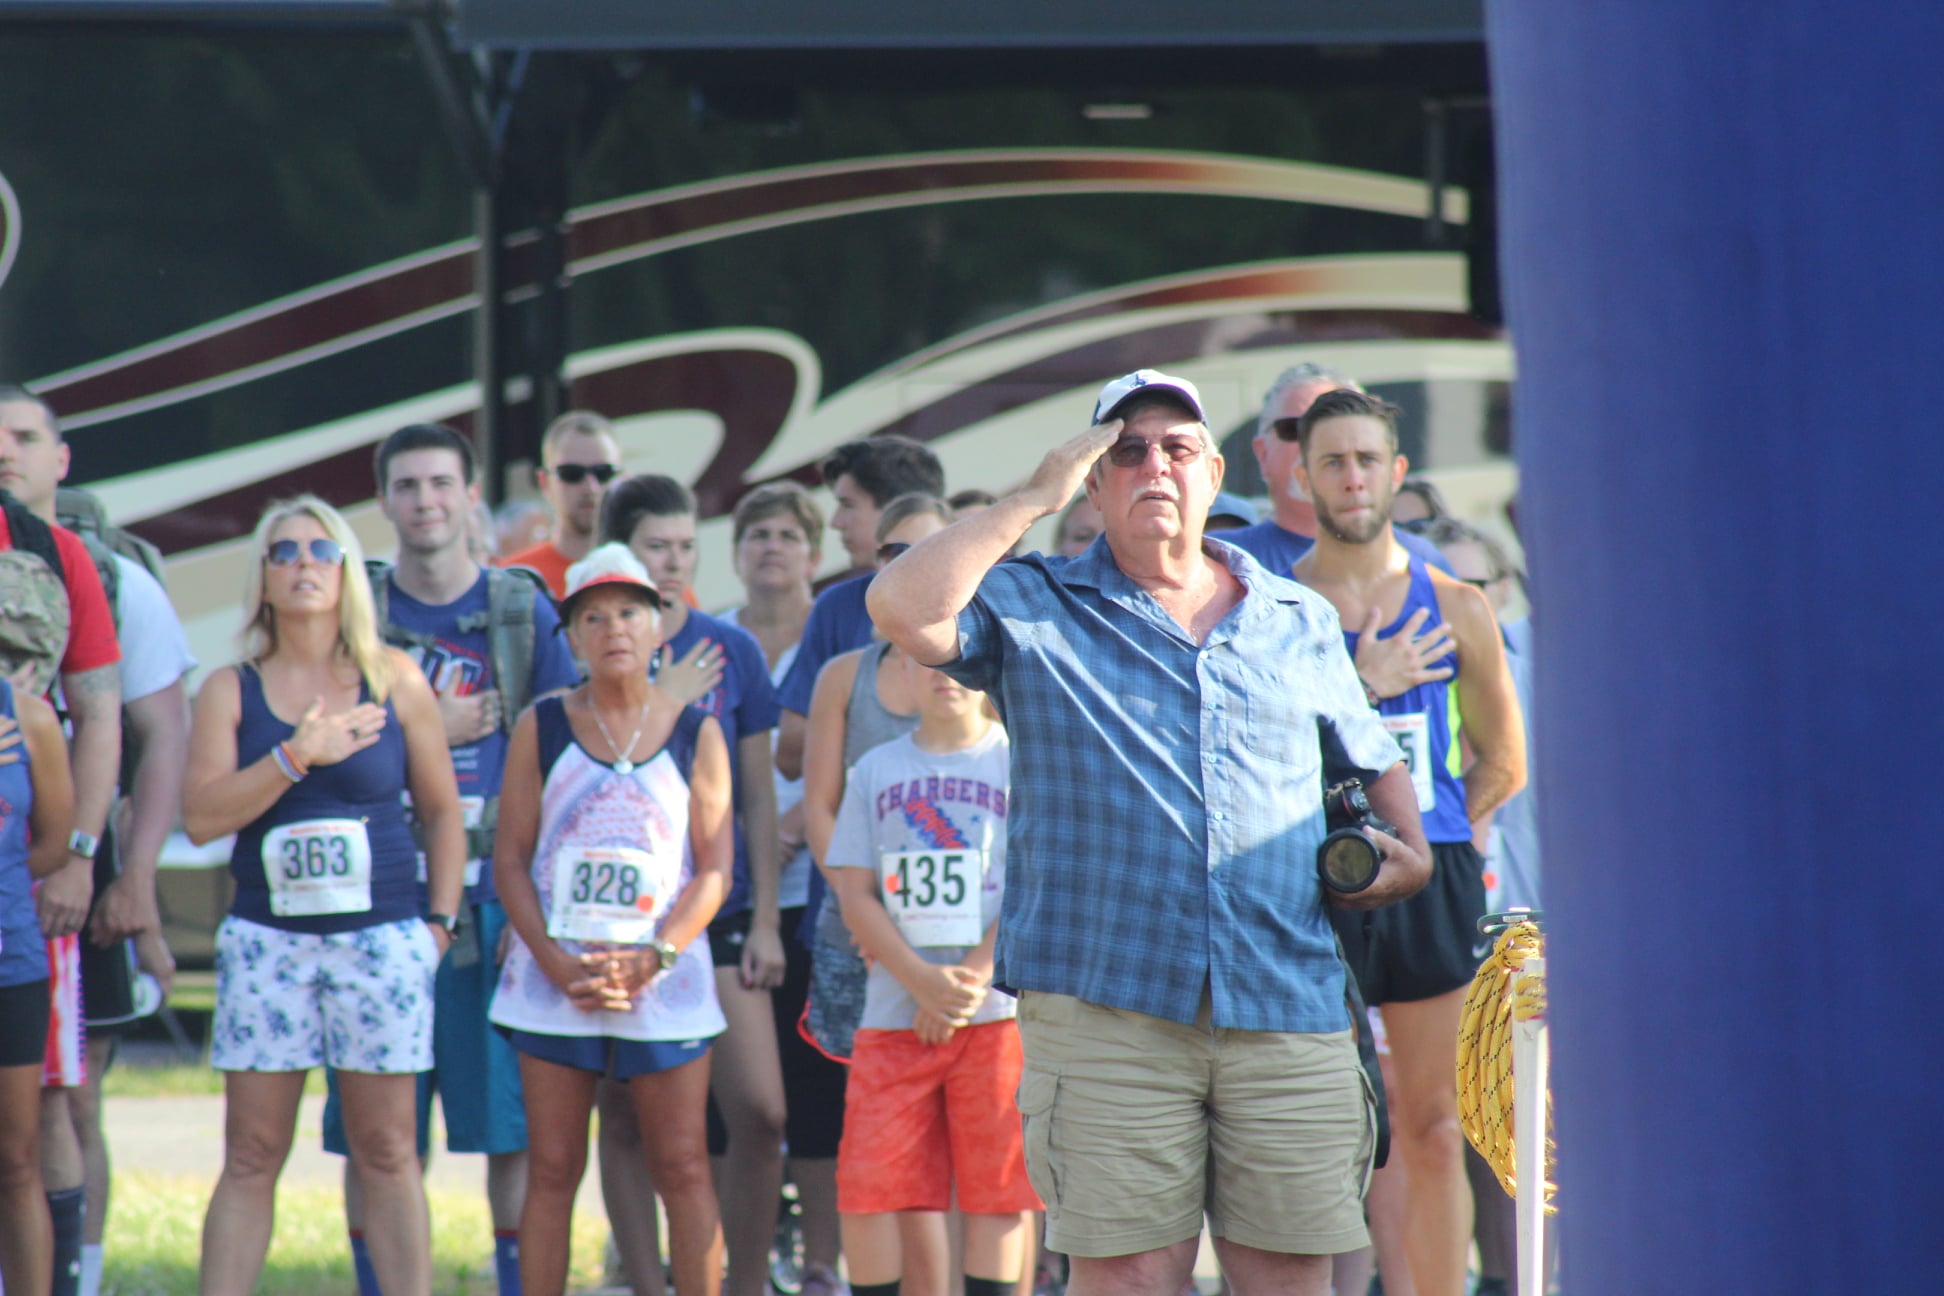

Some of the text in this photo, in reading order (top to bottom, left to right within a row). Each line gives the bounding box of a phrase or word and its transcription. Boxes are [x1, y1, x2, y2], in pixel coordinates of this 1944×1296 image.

[877, 778, 1007, 821] CHARGERS
[283, 836, 350, 880] 363
[573, 862, 640, 906] 328
[893, 855, 966, 908] 435
